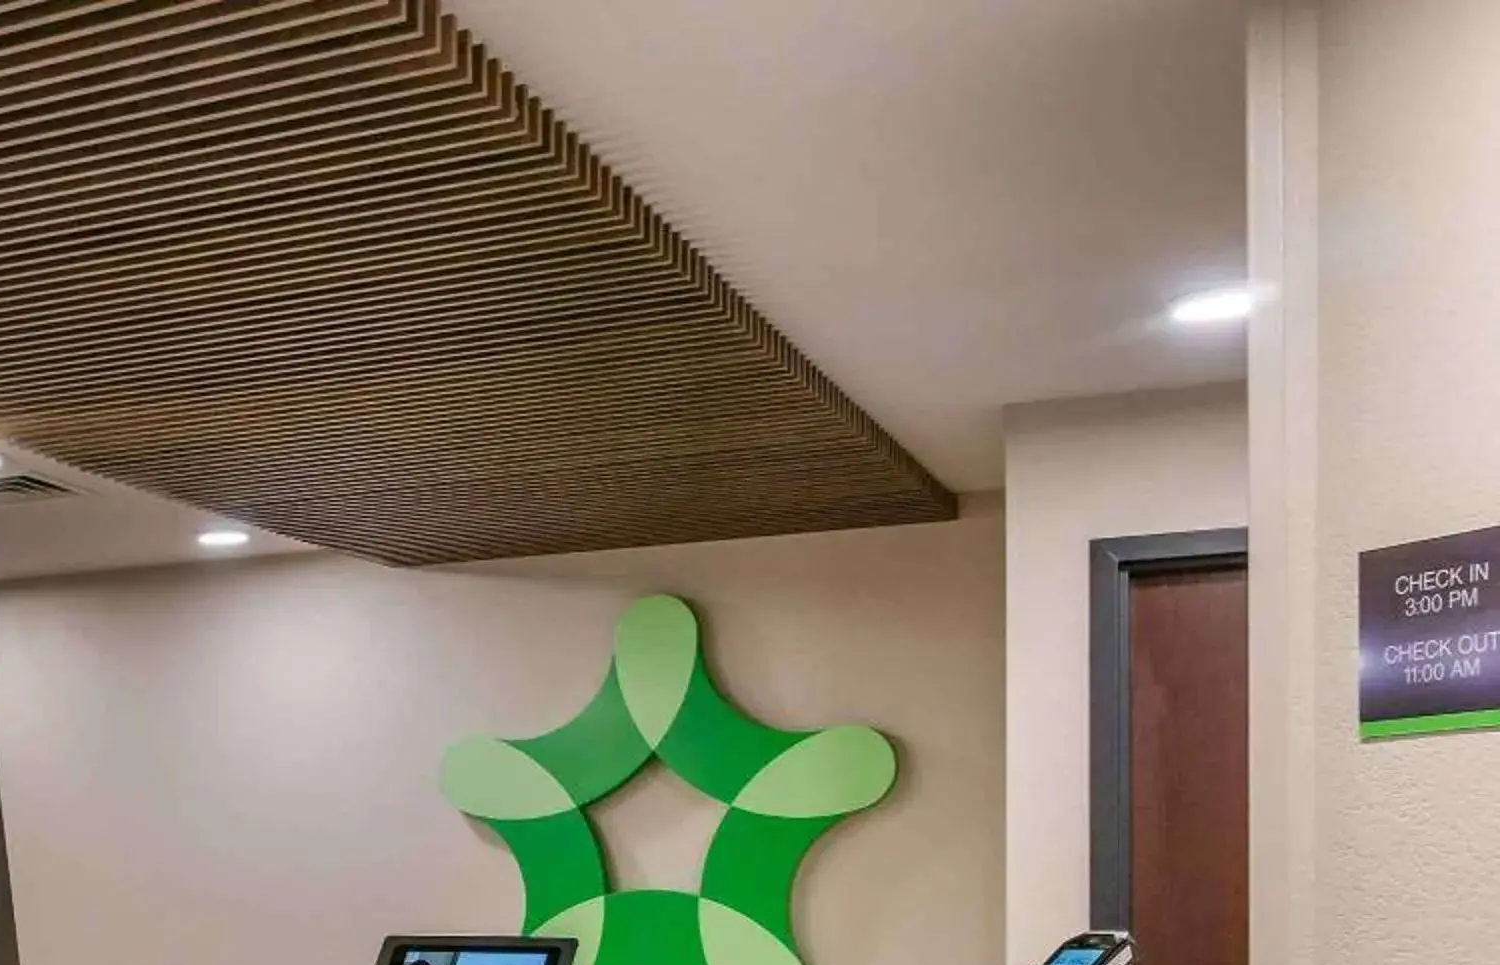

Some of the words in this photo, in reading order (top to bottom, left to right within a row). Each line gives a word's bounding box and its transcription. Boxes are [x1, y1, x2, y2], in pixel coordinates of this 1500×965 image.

[1395, 566, 1463, 595] CHECK
[1469, 562, 1489, 582] IN
[1405, 594, 1443, 616] 3:00
[1449, 588, 1479, 608] PM
[1384, 639, 1452, 664] CHECK
[1458, 631, 1500, 654] OUT
[1404, 663, 1445, 684] 11:00
[1451, 658, 1481, 678] AM
